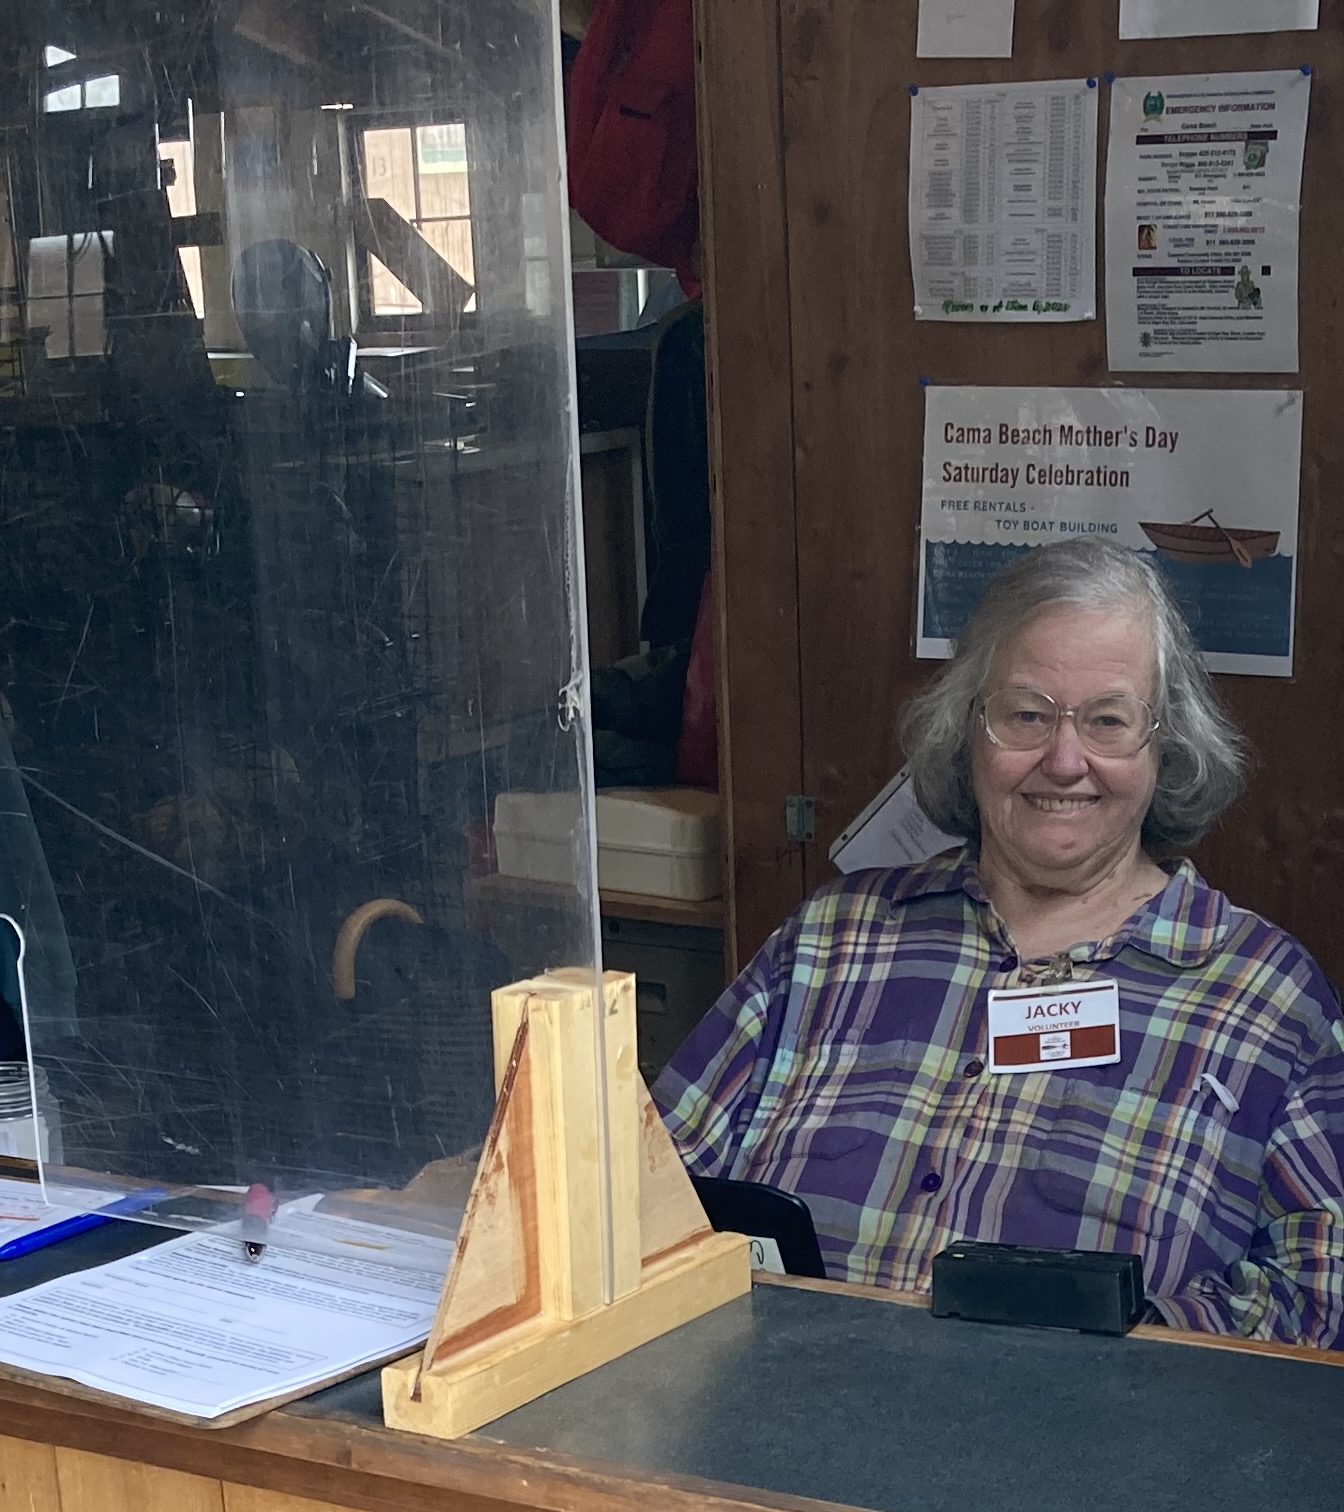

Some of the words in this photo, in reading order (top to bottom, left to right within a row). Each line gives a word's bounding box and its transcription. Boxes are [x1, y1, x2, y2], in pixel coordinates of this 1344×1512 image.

[944, 422, 991, 444] Cama
[999, 423, 1052, 446] Beach
[1059, 424, 1137, 447] Mother's
[1145, 425, 1179, 453] Day
[942, 461, 1020, 488] Saturday
[1026, 463, 1130, 488] Celebration
[940, 500, 969, 511] FREE
[973, 500, 1026, 513] RENTALS
[995, 519, 1020, 530] TOY
[1023, 520, 1055, 531] BOAT
[1060, 521, 1118, 534] BUILDING
[1025, 1000, 1082, 1020] JACKY
[1027, 1020, 1080, 1031] VOLUNTEER
